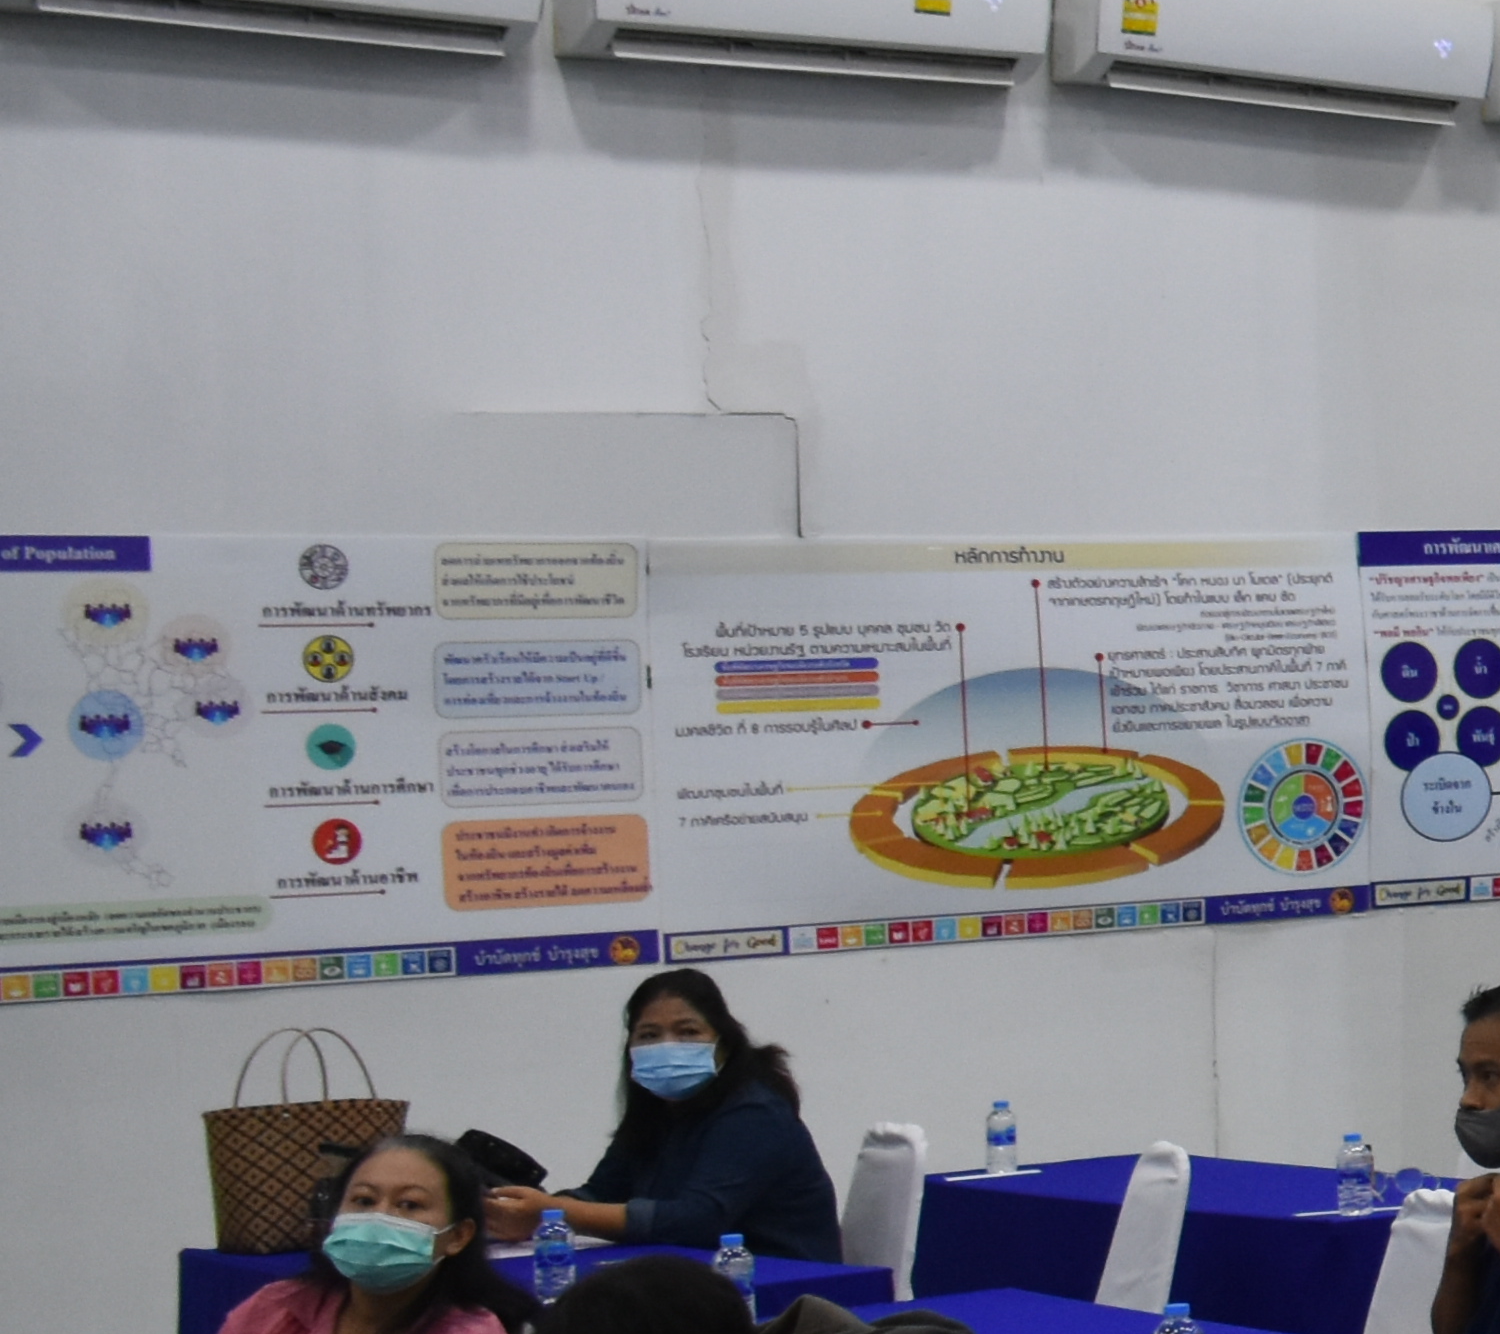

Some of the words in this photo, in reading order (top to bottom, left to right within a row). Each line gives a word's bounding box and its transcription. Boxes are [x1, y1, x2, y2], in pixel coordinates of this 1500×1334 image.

[1, 546, 20, 560] of
[24, 546, 117, 564] Population
[954, 545, 1066, 565] หลักการทำงาน
[262, 600, 432, 618] การพัฒนาด้านทรัพยากร
[266, 685, 409, 703] การพัฒนาด้านสังคม
[269, 777, 435, 798] การพัฒนาด้านการศึกษา
[277, 867, 420, 889] การพัฒนาด้านอาชีพ
[1220, 897, 1275, 918] บำบัดทุกข์
[1280, 896, 1322, 914] บำรุงสุข
[474, 946, 542, 967] บำบัดทุกข์
[547, 945, 600, 964] บำรุงสุข
